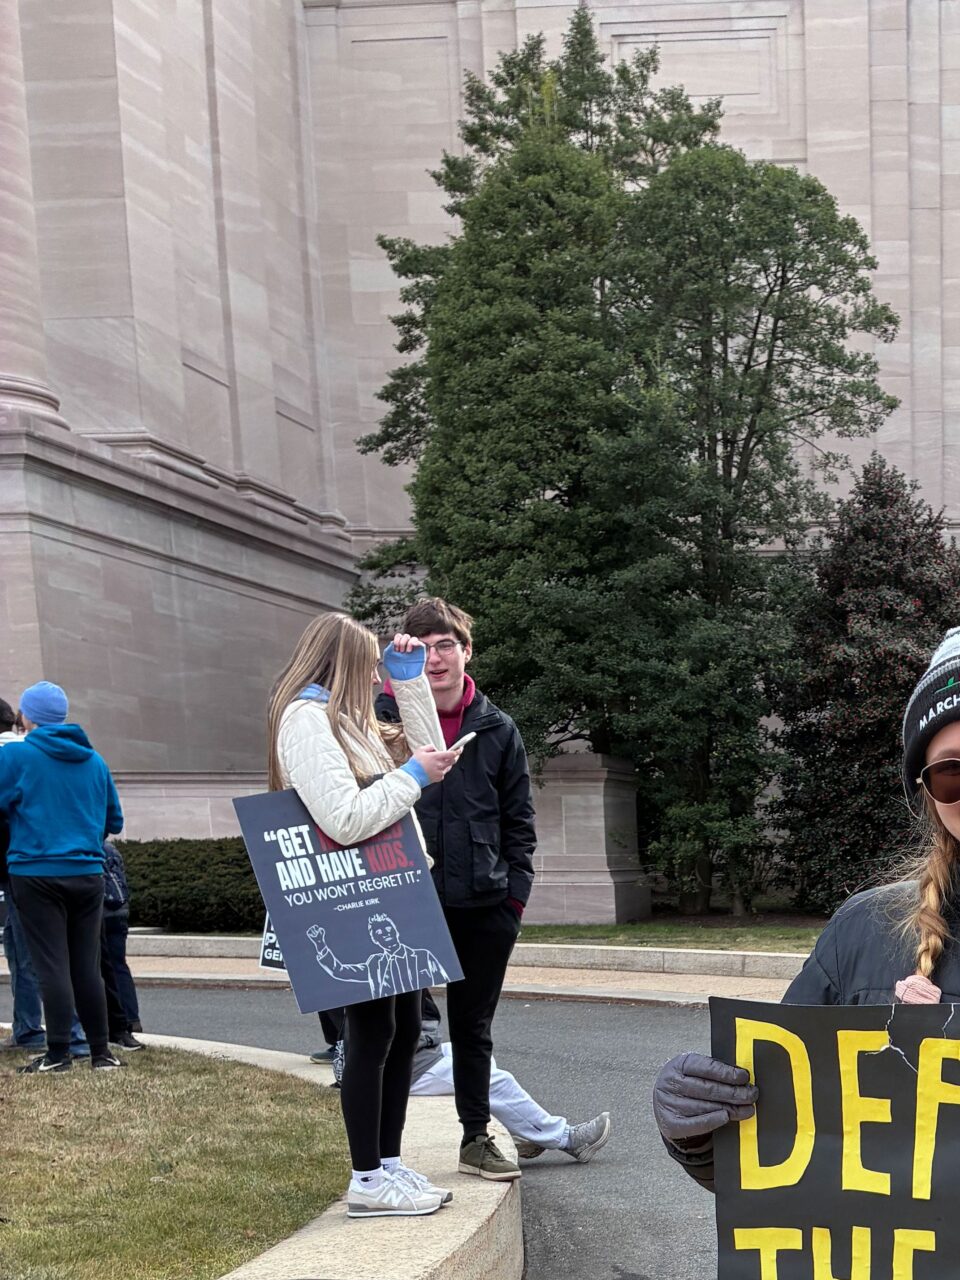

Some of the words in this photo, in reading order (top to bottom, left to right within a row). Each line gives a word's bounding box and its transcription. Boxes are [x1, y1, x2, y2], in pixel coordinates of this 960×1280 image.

[263, 824, 315, 859] “GET
[275, 857, 317, 891] AND
[315, 847, 367, 883] HAVE
[365, 841, 415, 873] KIDS.
[284, 890, 313, 907] YOU
[313, 882, 356, 901] WON'T
[358, 873, 403, 893] REGRET
[365, 897, 380, 906] KIRK
